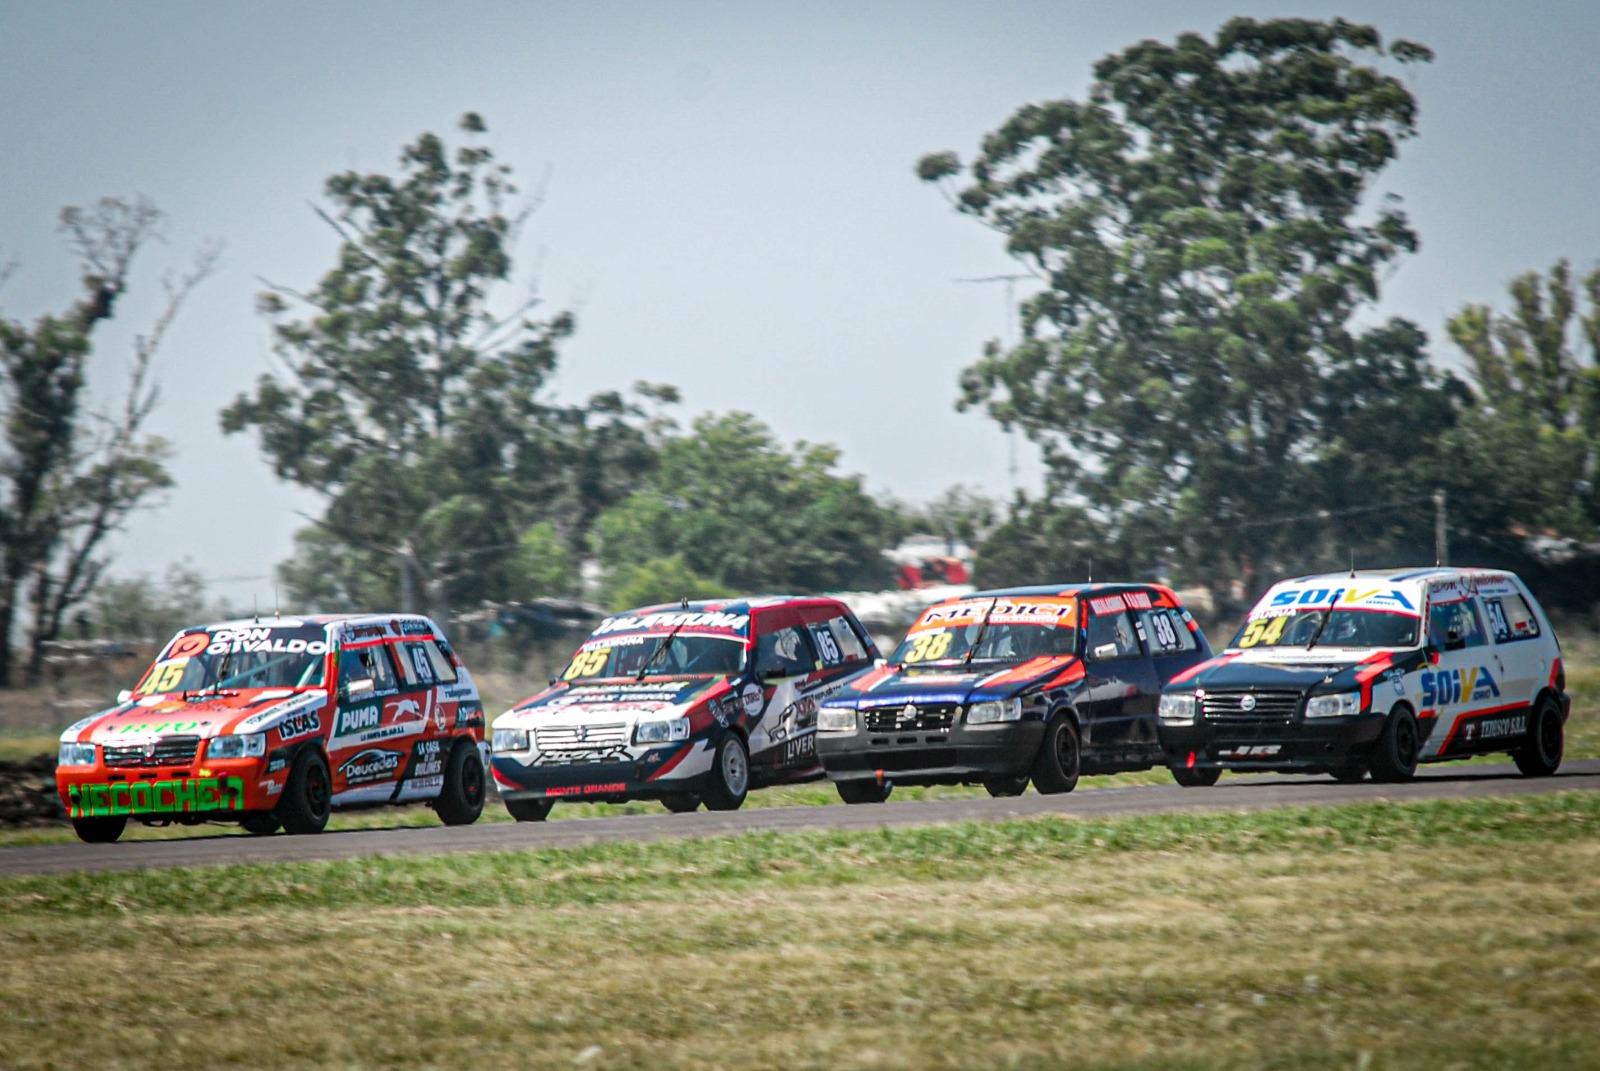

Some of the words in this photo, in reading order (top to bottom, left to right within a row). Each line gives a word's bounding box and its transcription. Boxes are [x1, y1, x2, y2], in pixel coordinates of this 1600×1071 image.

[211, 628, 272, 643] DON
[1153, 614, 1176, 645] 38
[1238, 616, 1288, 648] 54
[905, 632, 952, 663] 38
[140, 662, 188, 694] 45
[564, 647, 612, 680] 85
[279, 710, 320, 739] ISLAS
[341, 705, 378, 732] PUMA
